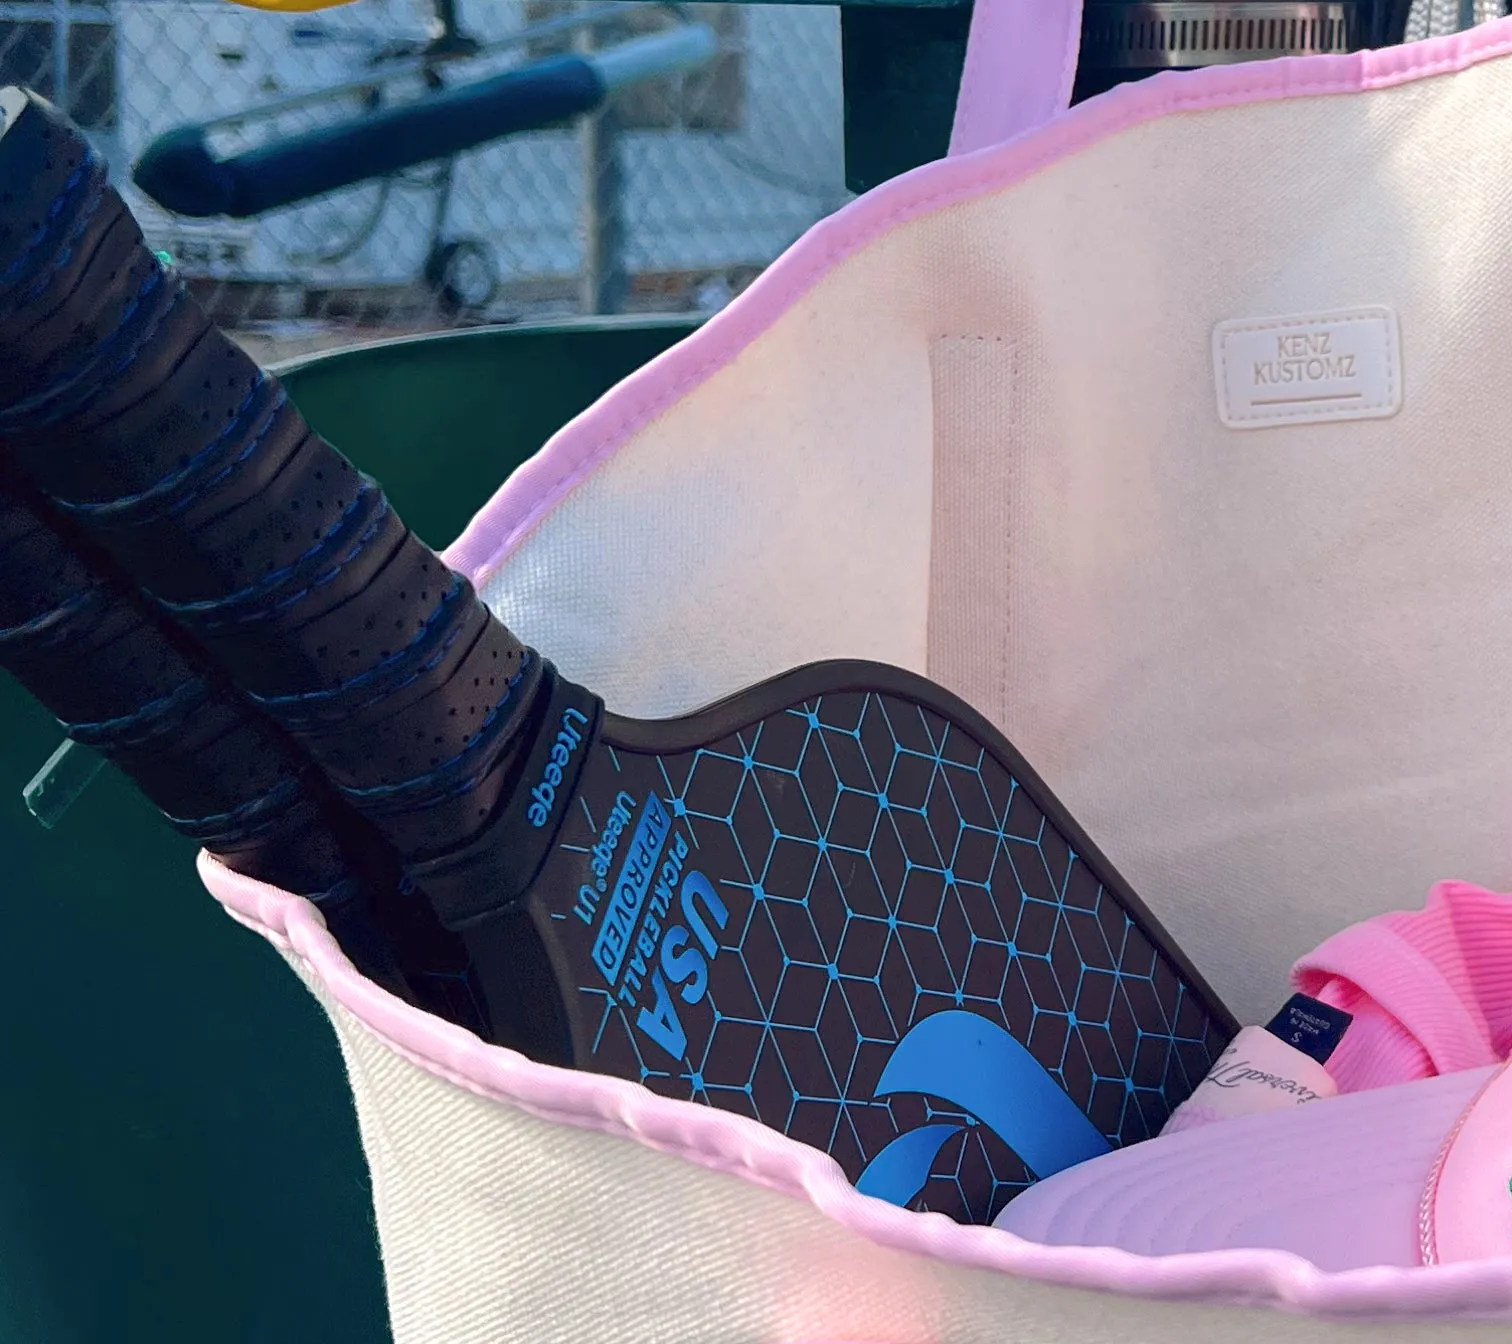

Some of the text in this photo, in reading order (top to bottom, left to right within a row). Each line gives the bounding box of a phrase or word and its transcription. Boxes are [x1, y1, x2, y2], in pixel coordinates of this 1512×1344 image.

[1253, 355, 1357, 385] KUSTOMZ
[1277, 332, 1332, 358] KENZ
[527, 707, 589, 828] Uteeqe
[573, 884, 601, 925] U1
[599, 799, 670, 982] APPROVED
[616, 831, 689, 1007] PICKLEBALL
[636, 870, 730, 1061] USA
